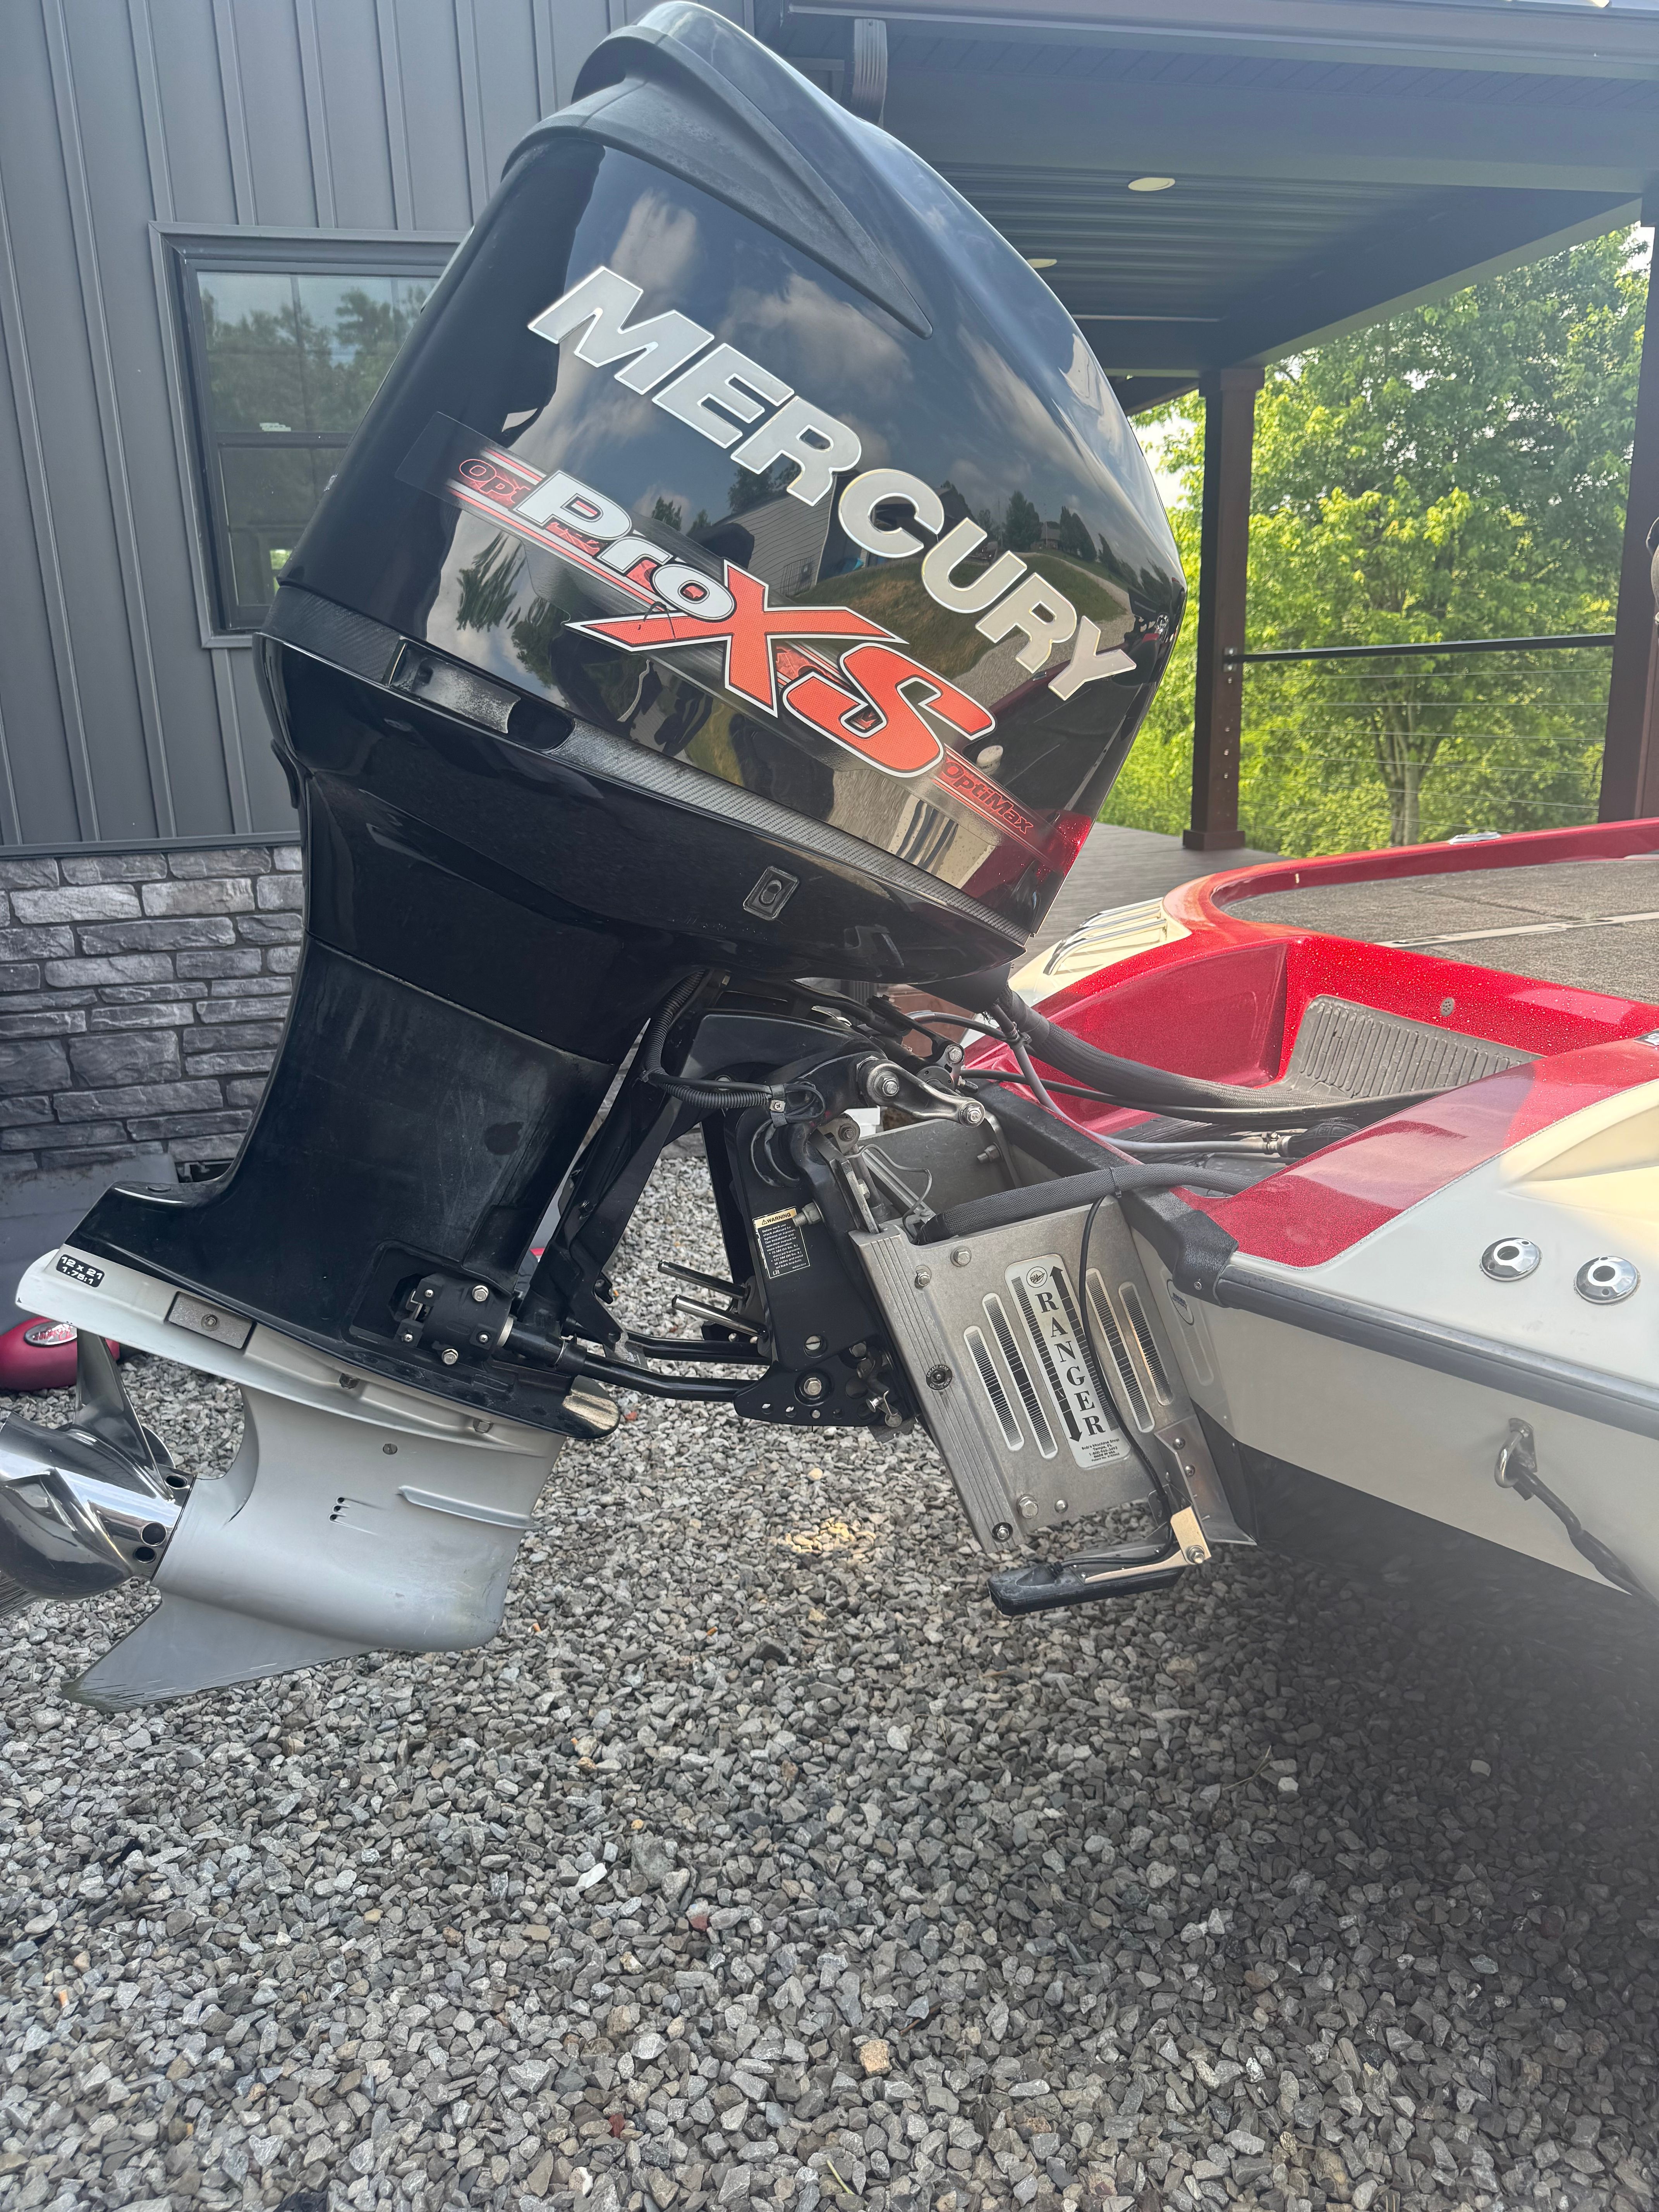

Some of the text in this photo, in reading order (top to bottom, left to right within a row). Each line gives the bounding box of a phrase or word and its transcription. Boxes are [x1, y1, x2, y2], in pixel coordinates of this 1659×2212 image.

[527, 266, 1137, 701] MERCURY
[513, 470, 996, 778] Pro XS
[941, 760, 1034, 834] OptiMax
[767, 1212, 791, 1223] WARNING
[61, 1257, 76, 1267] 12
[86, 1268, 103, 1280] 21
[62, 1266, 94, 1284] 1.75:1
[1035, 1291, 1106, 1436] RANGER
